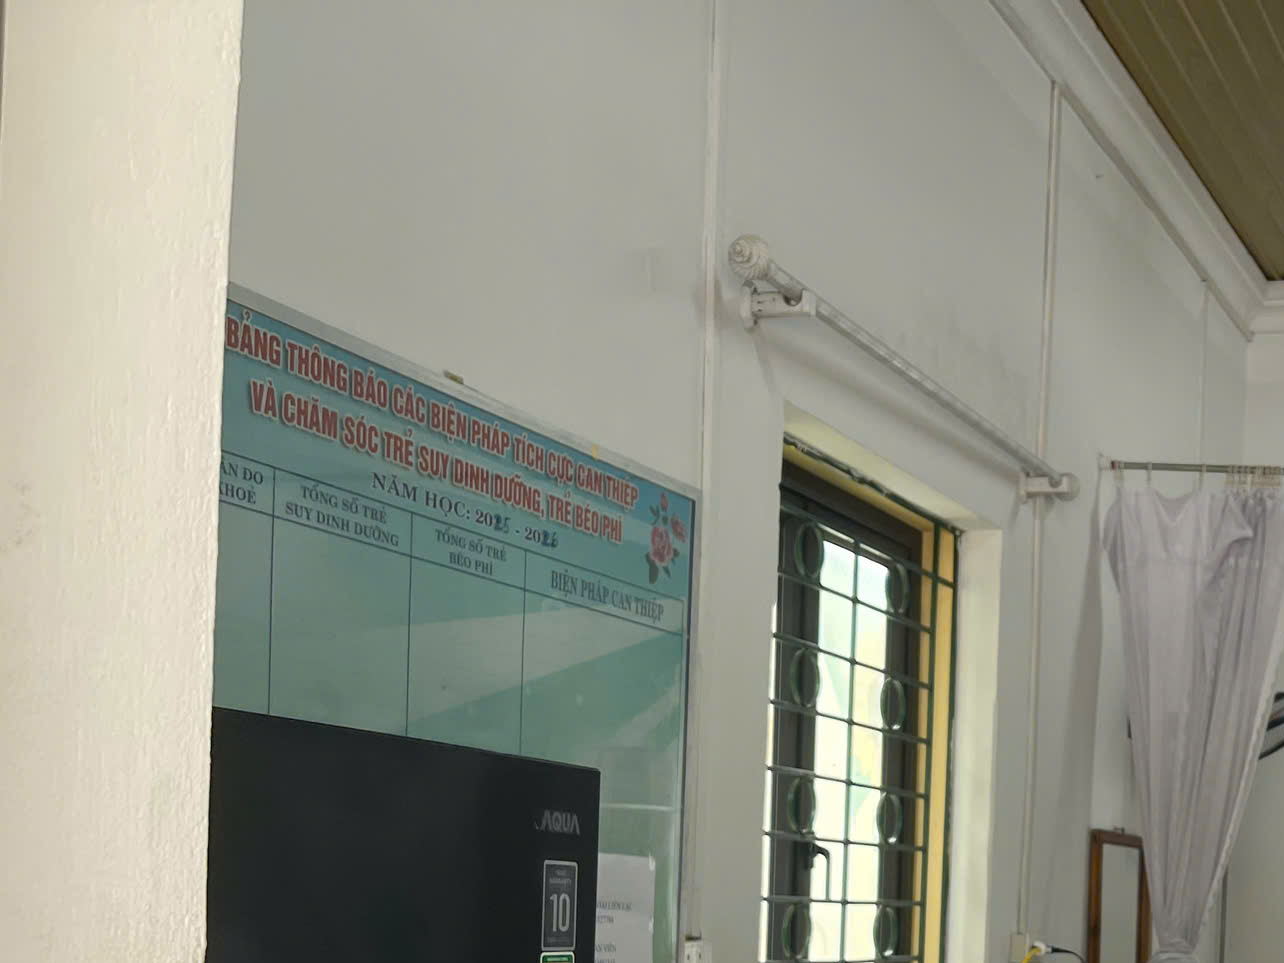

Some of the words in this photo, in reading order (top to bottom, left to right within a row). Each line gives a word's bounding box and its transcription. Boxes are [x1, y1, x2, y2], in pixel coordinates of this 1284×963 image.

[225, 309, 282, 368] BẢNG
[286, 342, 349, 395] THÔNG
[352, 368, 388, 408] BÁO
[392, 386, 426, 424] CÁC
[430, 402, 468, 440] BIỆN
[471, 418, 510, 456] PHÁP
[514, 435, 544, 472] TÍCH
[548, 450, 574, 485] CỰC
[577, 463, 603, 494] CAN
[606, 475, 640, 511] THIỆP
[251, 378, 278, 418] VÀ
[282, 393, 338, 441] CHĂM
[342, 416, 379, 455] SÓC
[384, 428, 414, 468] TRẺ
[418, 444, 451, 480] SUY
[453, 457, 491, 495] DINH
[548, 491, 573, 525] TRẺ
[575, 503, 599, 535] BÉO
[285, 501, 313, 520] SUY
[317, 510, 350, 533] DINH
[371, 472, 417, 502] NĂM
[425, 490, 470, 519] HỌC:
[549, 892, 570, 932] 10
